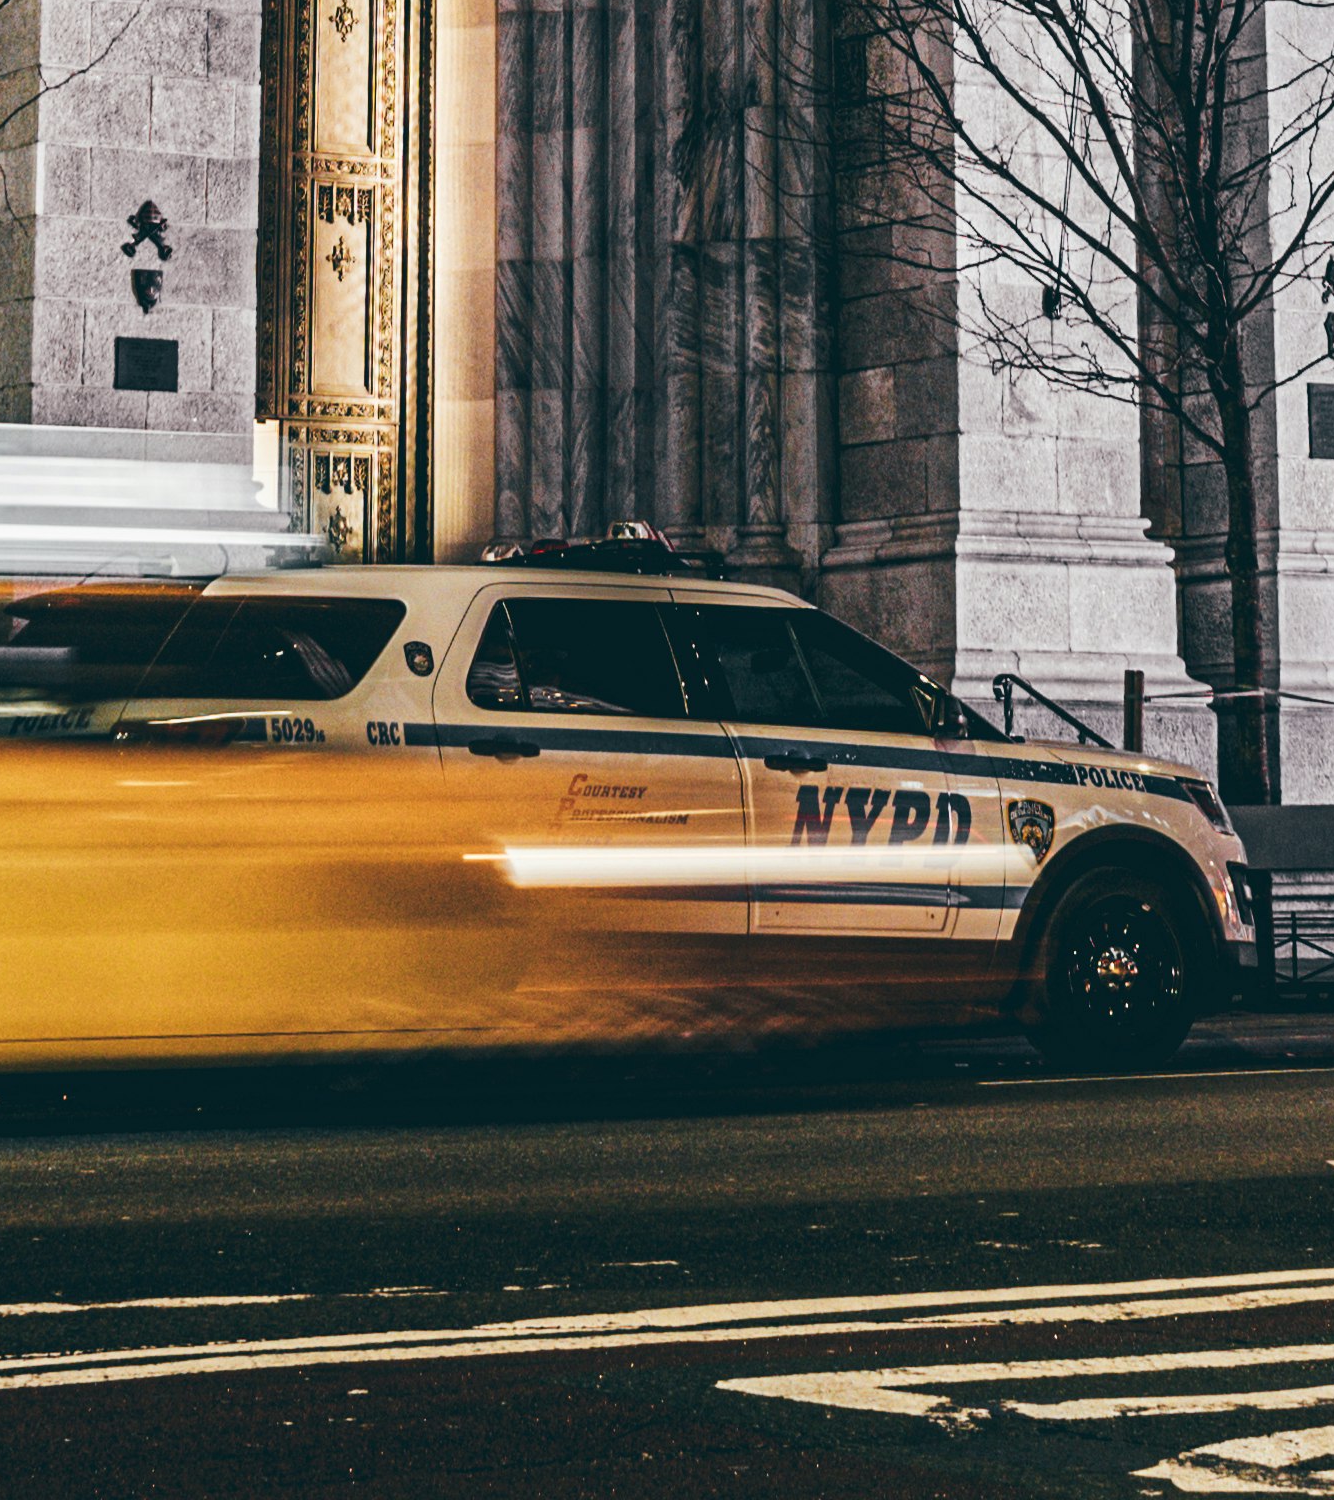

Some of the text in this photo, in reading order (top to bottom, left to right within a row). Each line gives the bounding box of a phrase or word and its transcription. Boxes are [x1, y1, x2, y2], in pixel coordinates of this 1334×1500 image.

[367, 720, 401, 746] CRC
[568, 773, 647, 799] COURTESY
[1075, 764, 1146, 792] POLICE
[788, 784, 972, 855] NYPD
